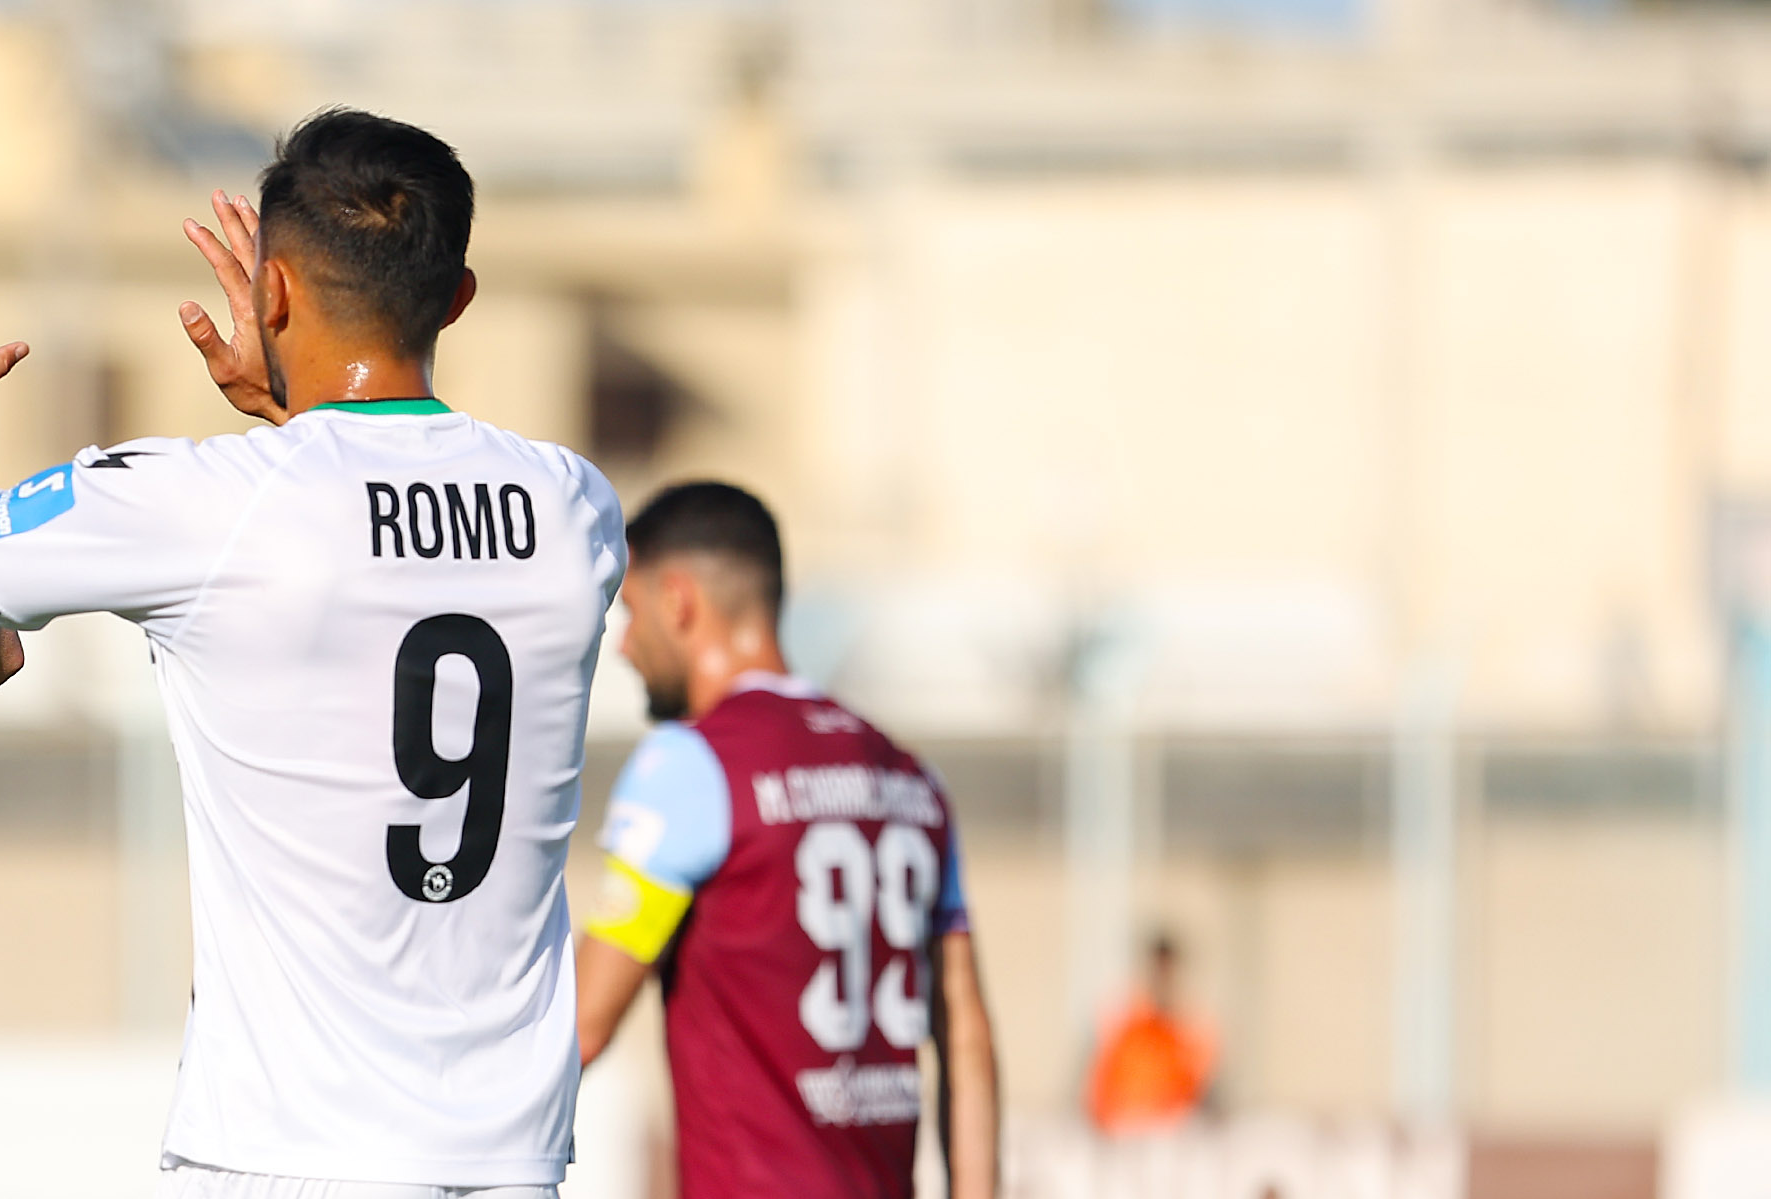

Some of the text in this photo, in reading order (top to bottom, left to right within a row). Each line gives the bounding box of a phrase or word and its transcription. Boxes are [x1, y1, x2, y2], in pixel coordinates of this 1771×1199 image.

[365, 482, 537, 560] ROMO
[385, 612, 514, 904] 9
[794, 823, 941, 1052] 99
